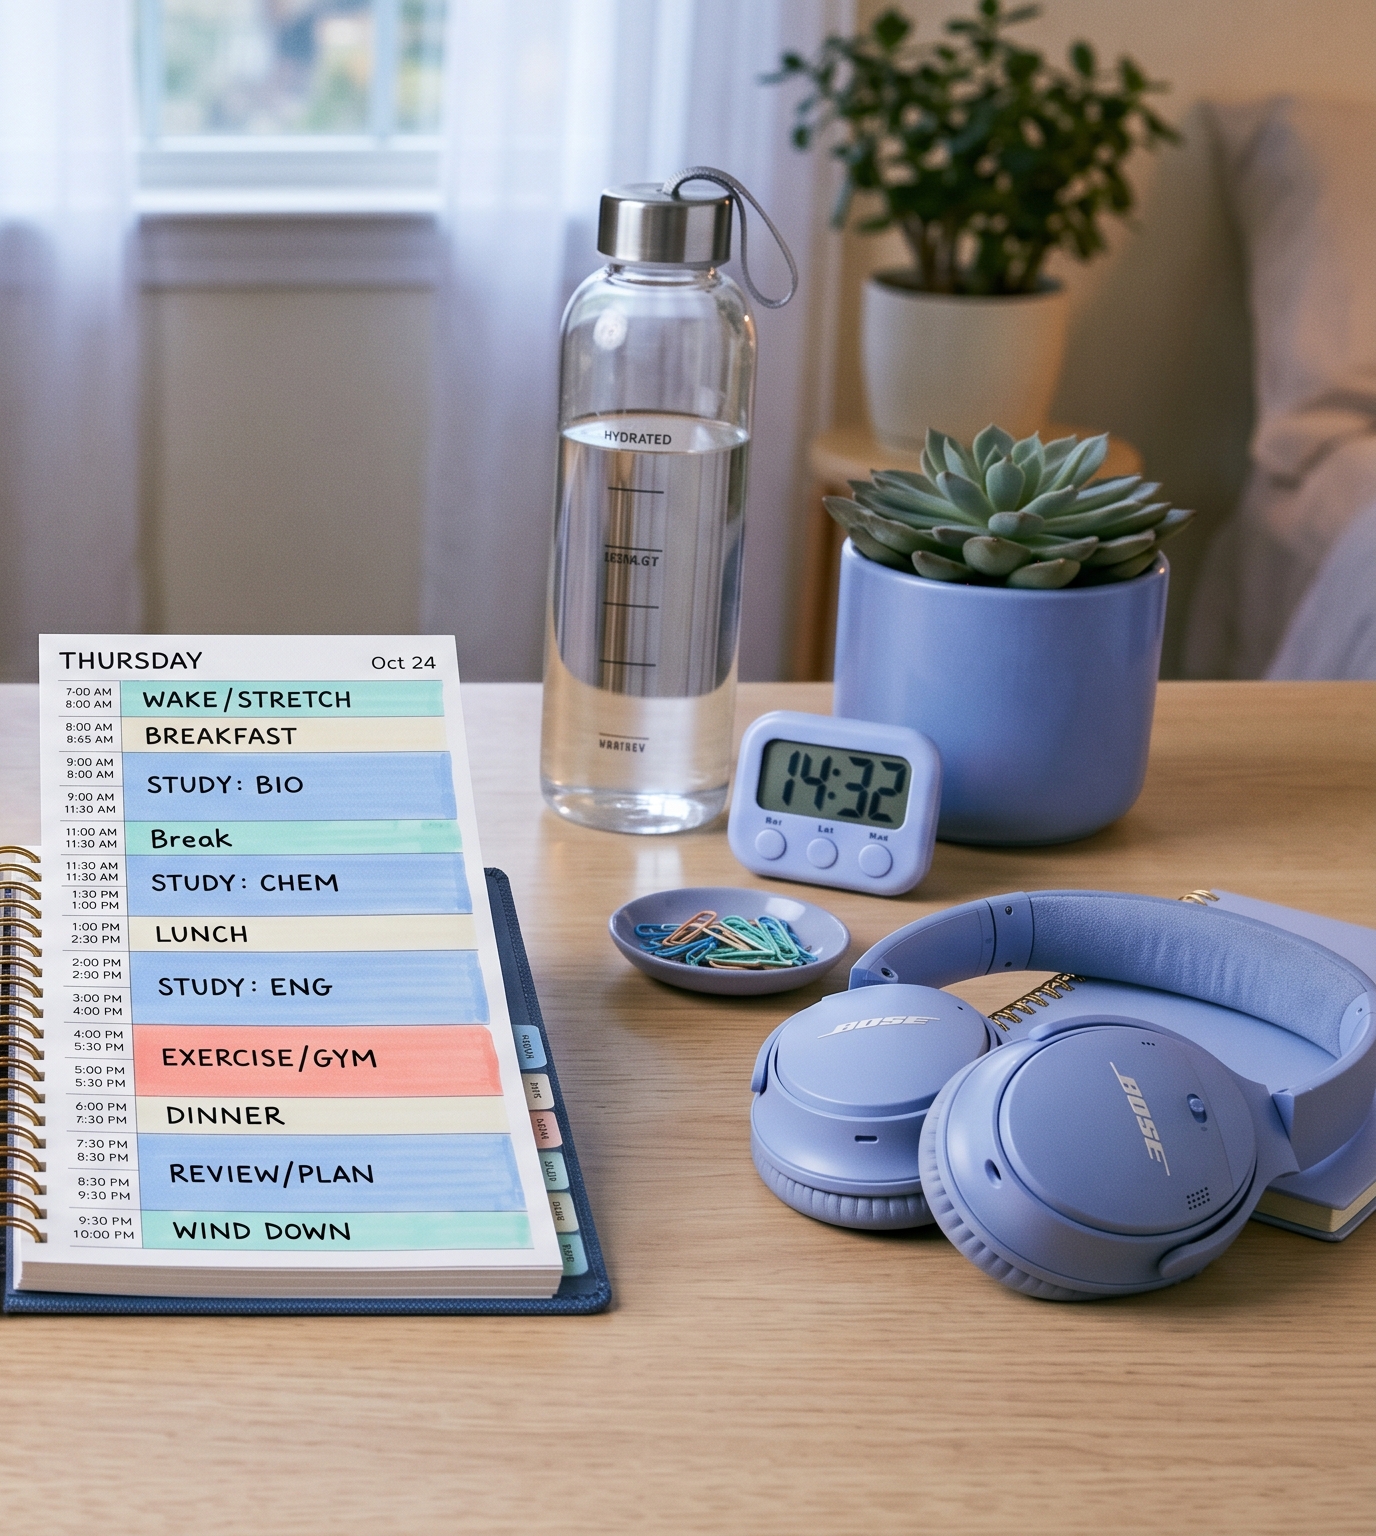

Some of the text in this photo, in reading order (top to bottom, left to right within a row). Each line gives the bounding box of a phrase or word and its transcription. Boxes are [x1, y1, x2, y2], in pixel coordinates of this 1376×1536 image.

[604, 430, 673, 445] HYDRATED
[58, 651, 203, 670] THURSDAY
[371, 656, 436, 670] Oct 24
[93, 688, 112, 696] AM
[65, 700, 91, 708] 8:00
[142, 687, 351, 713] WAKE/STRETCH
[65, 723, 113, 731] 8:00 AM
[66, 735, 92, 743] 8:65
[145, 726, 297, 745] BREAKFAST
[66, 758, 93, 766] 9:00
[67, 770, 93, 778] 8:00
[147, 775, 303, 795] STUDY: BIO
[782, 750, 907, 824] 14:32
[67, 793, 93, 801] 9:00
[64, 805, 94, 813] 11:30
[66, 828, 96, 836] 11:00
[151, 828, 233, 849] Break
[66, 840, 117, 848] 11:30 AM
[99, 862, 119, 870] AM
[66, 873, 119, 881] 11:30 AM
[151, 873, 339, 892] STUDY: CHEM
[72, 890, 97, 898] 1:30
[72, 901, 97, 909] 1:00
[72, 923, 120, 931] 1:00 PM
[156, 925, 248, 943] LUNCH
[71, 935, 121, 943] 2:30 PM
[72, 958, 100, 966] 2:00
[103, 971, 122, 979] PM
[158, 977, 333, 998] STUDY: ENG
[72, 994, 122, 1003] 3:00 PM
[72, 1007, 100, 1015] 4:00
[817, 1015, 941, 1039] BOSE
[73, 1030, 101, 1038] 4:00
[74, 1043, 124, 1051] 5:30 PM
[162, 1045, 377, 1073] EXERCISE/GYM
[74, 1066, 103, 1074] 5:00
[75, 1079, 126, 1087] 5:30 PM
[75, 1102, 127, 1111] 6:00 PM
[107, 1116, 127, 1124] PM
[166, 1106, 286, 1126] DINNER
[1109, 1061, 1171, 1176] BOSE
[76, 1140, 128, 1148] 7:30 PM
[77, 1153, 129, 1162] 8:30 PM
[169, 1160, 374, 1189] REVIEW/PLAN
[77, 1177, 130, 1186] 8:30 PM
[77, 1191, 131, 1200] 9:30 PM
[78, 1216, 132, 1225] 9:30 PM
[73, 1230, 135, 1239] 10:00 PM
[172, 1221, 351, 1241] WIND DOWN
